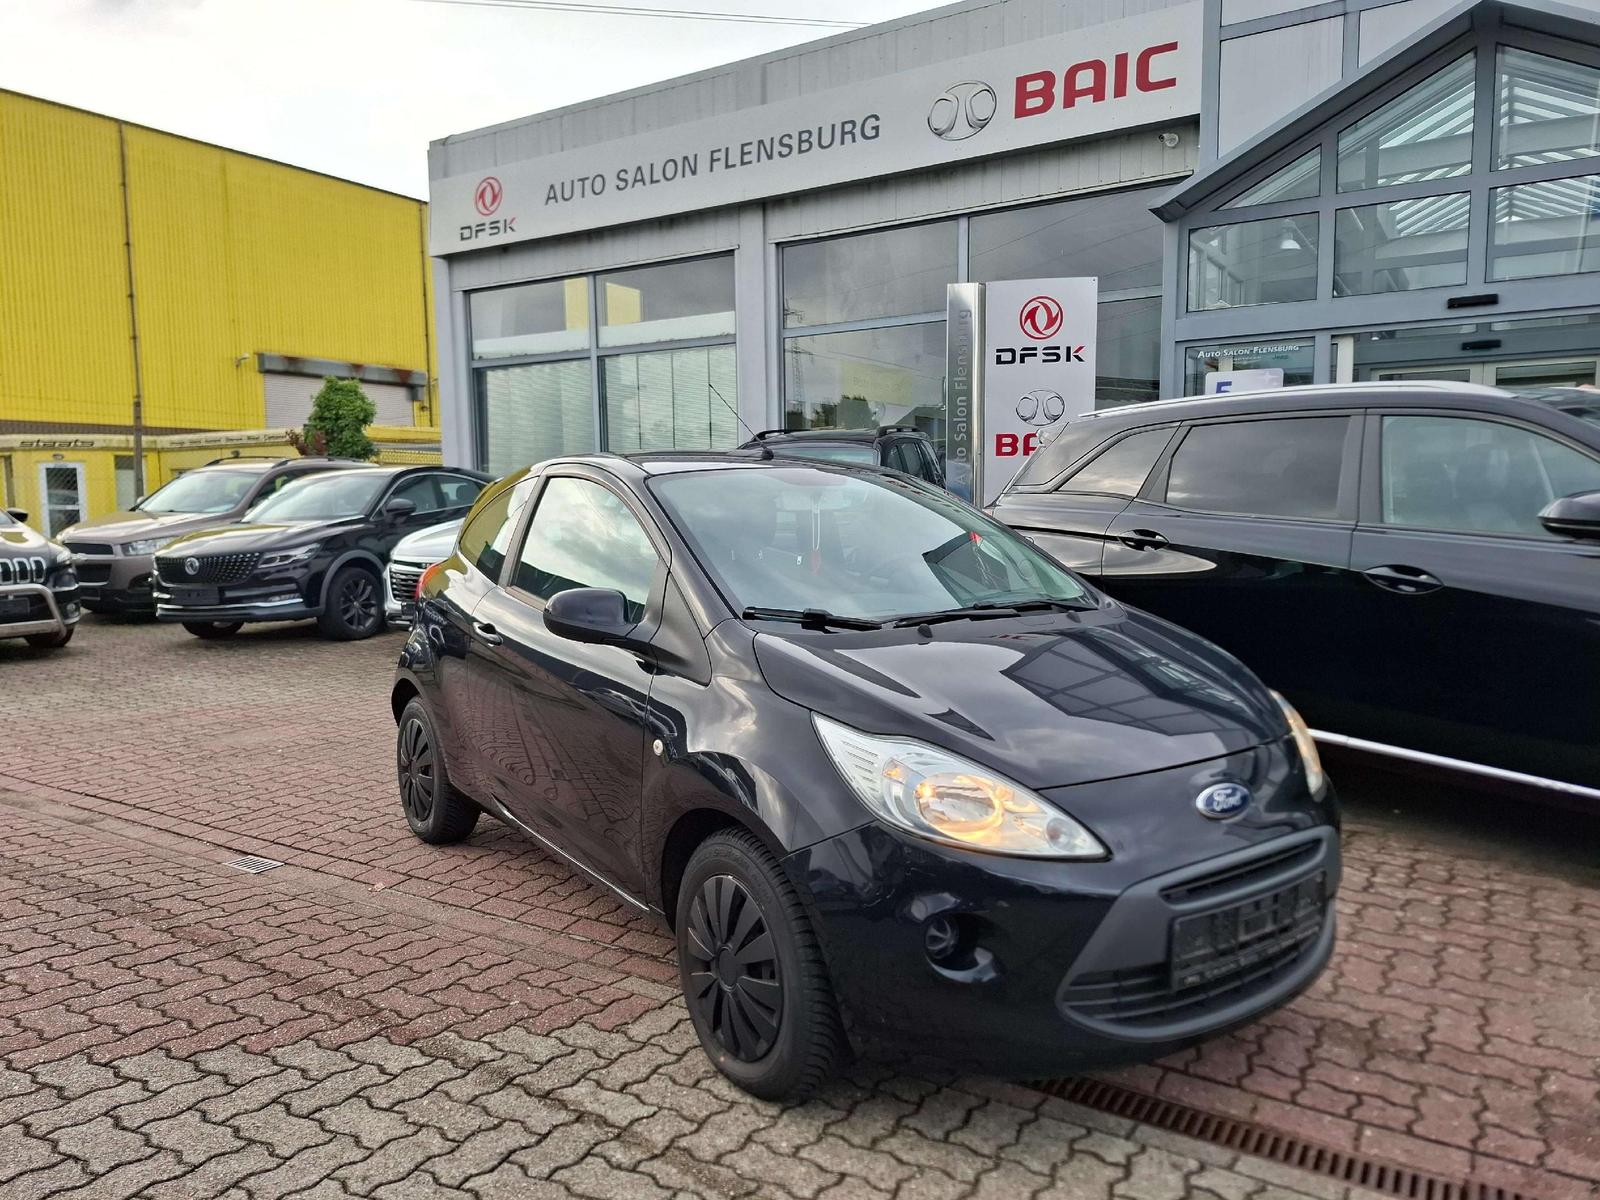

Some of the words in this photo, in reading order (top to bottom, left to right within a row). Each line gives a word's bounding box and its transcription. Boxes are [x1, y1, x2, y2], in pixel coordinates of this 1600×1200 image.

[1013, 41, 1178, 119] BAIC
[544, 174, 606, 206] AUTO
[615, 153, 698, 191] SALON
[708, 113, 881, 173] FLENSBURG
[460, 217, 516, 241] DFSK
[995, 345, 1086, 365] DFSK
[953, 396, 967, 442] Salon
